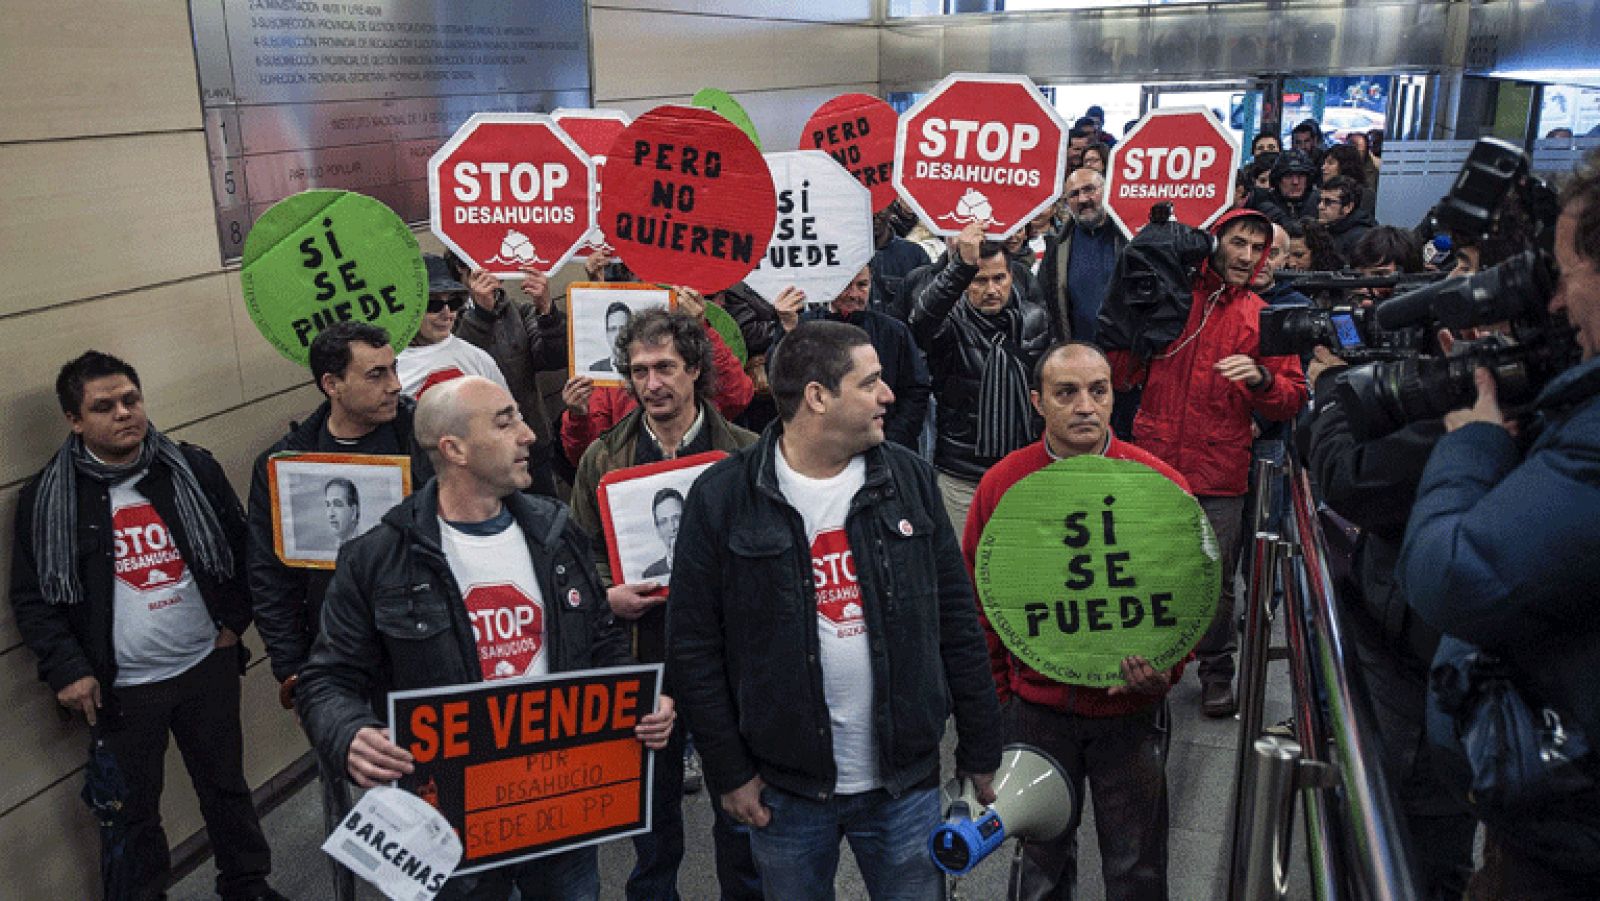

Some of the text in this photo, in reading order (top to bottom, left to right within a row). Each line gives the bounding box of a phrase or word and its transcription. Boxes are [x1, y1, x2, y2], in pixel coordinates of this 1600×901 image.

[813, 117, 870, 148] PERO
[918, 118, 1041, 164] STOP
[634, 140, 722, 179] PERO
[915, 160, 1041, 187] DESAHUCIOS
[1122, 146, 1217, 181] STOP
[225, 170, 236, 194] 5
[453, 162, 570, 203] STOP
[652, 179, 695, 213] NO
[1120, 183, 1216, 198] DESAHUCIOS
[231, 220, 242, 244] 8
[455, 206, 575, 225] DESAHUCIOS
[777, 217, 818, 241] SE
[756, 244, 840, 270] UEDE
[314, 260, 367, 302] SE
[114, 523, 176, 558] STO
[811, 550, 858, 588] STO
[1064, 552, 1137, 591] SE
[1024, 592, 1178, 637] PUEDE
[409, 680, 641, 763] SE VENDE
[526, 751, 569, 773] POR
[468, 812, 528, 849] SEDE
[536, 804, 571, 833] DEL
[582, 793, 615, 822] PP
[346, 811, 447, 893] BARCENAS
